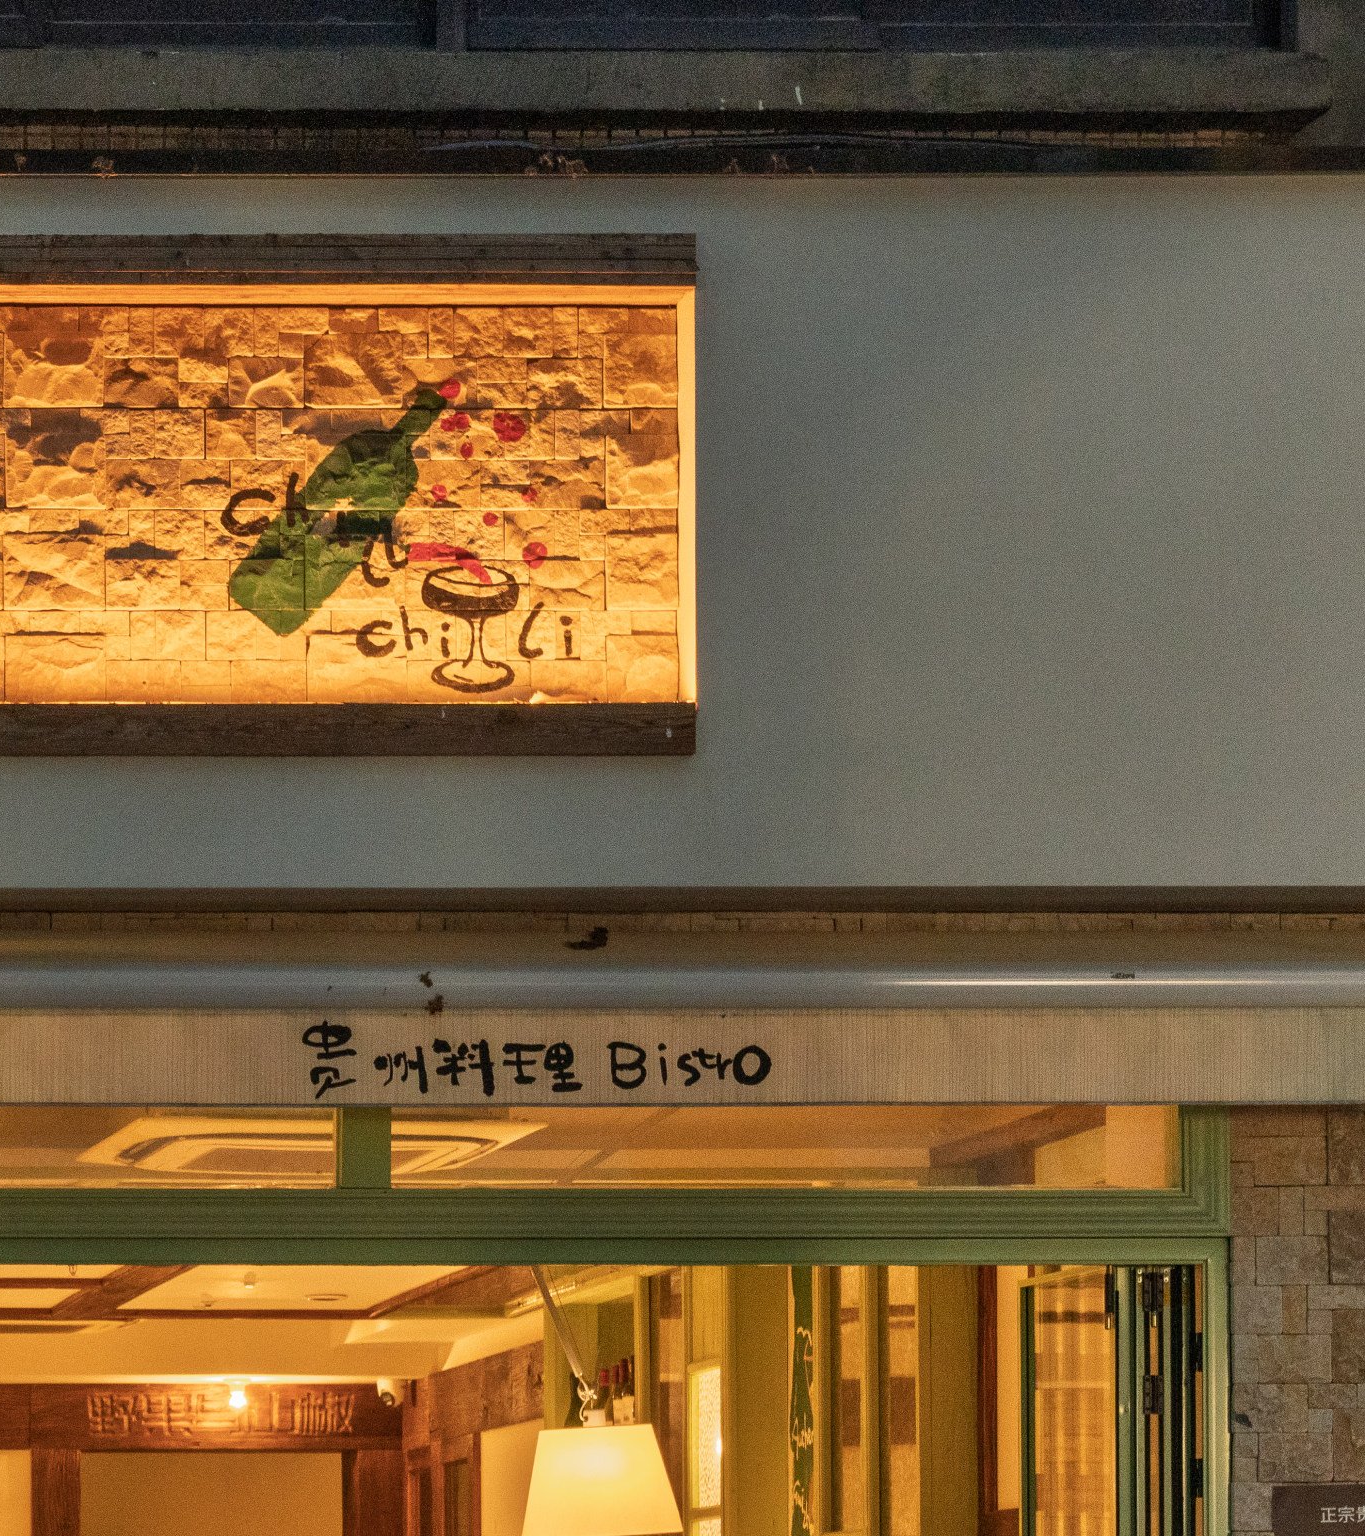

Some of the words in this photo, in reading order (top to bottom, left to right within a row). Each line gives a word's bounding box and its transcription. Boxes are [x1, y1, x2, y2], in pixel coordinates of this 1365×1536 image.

[302, 1020, 582, 1099] 贵州料理
[607, 1041, 772, 1090] Bistro
